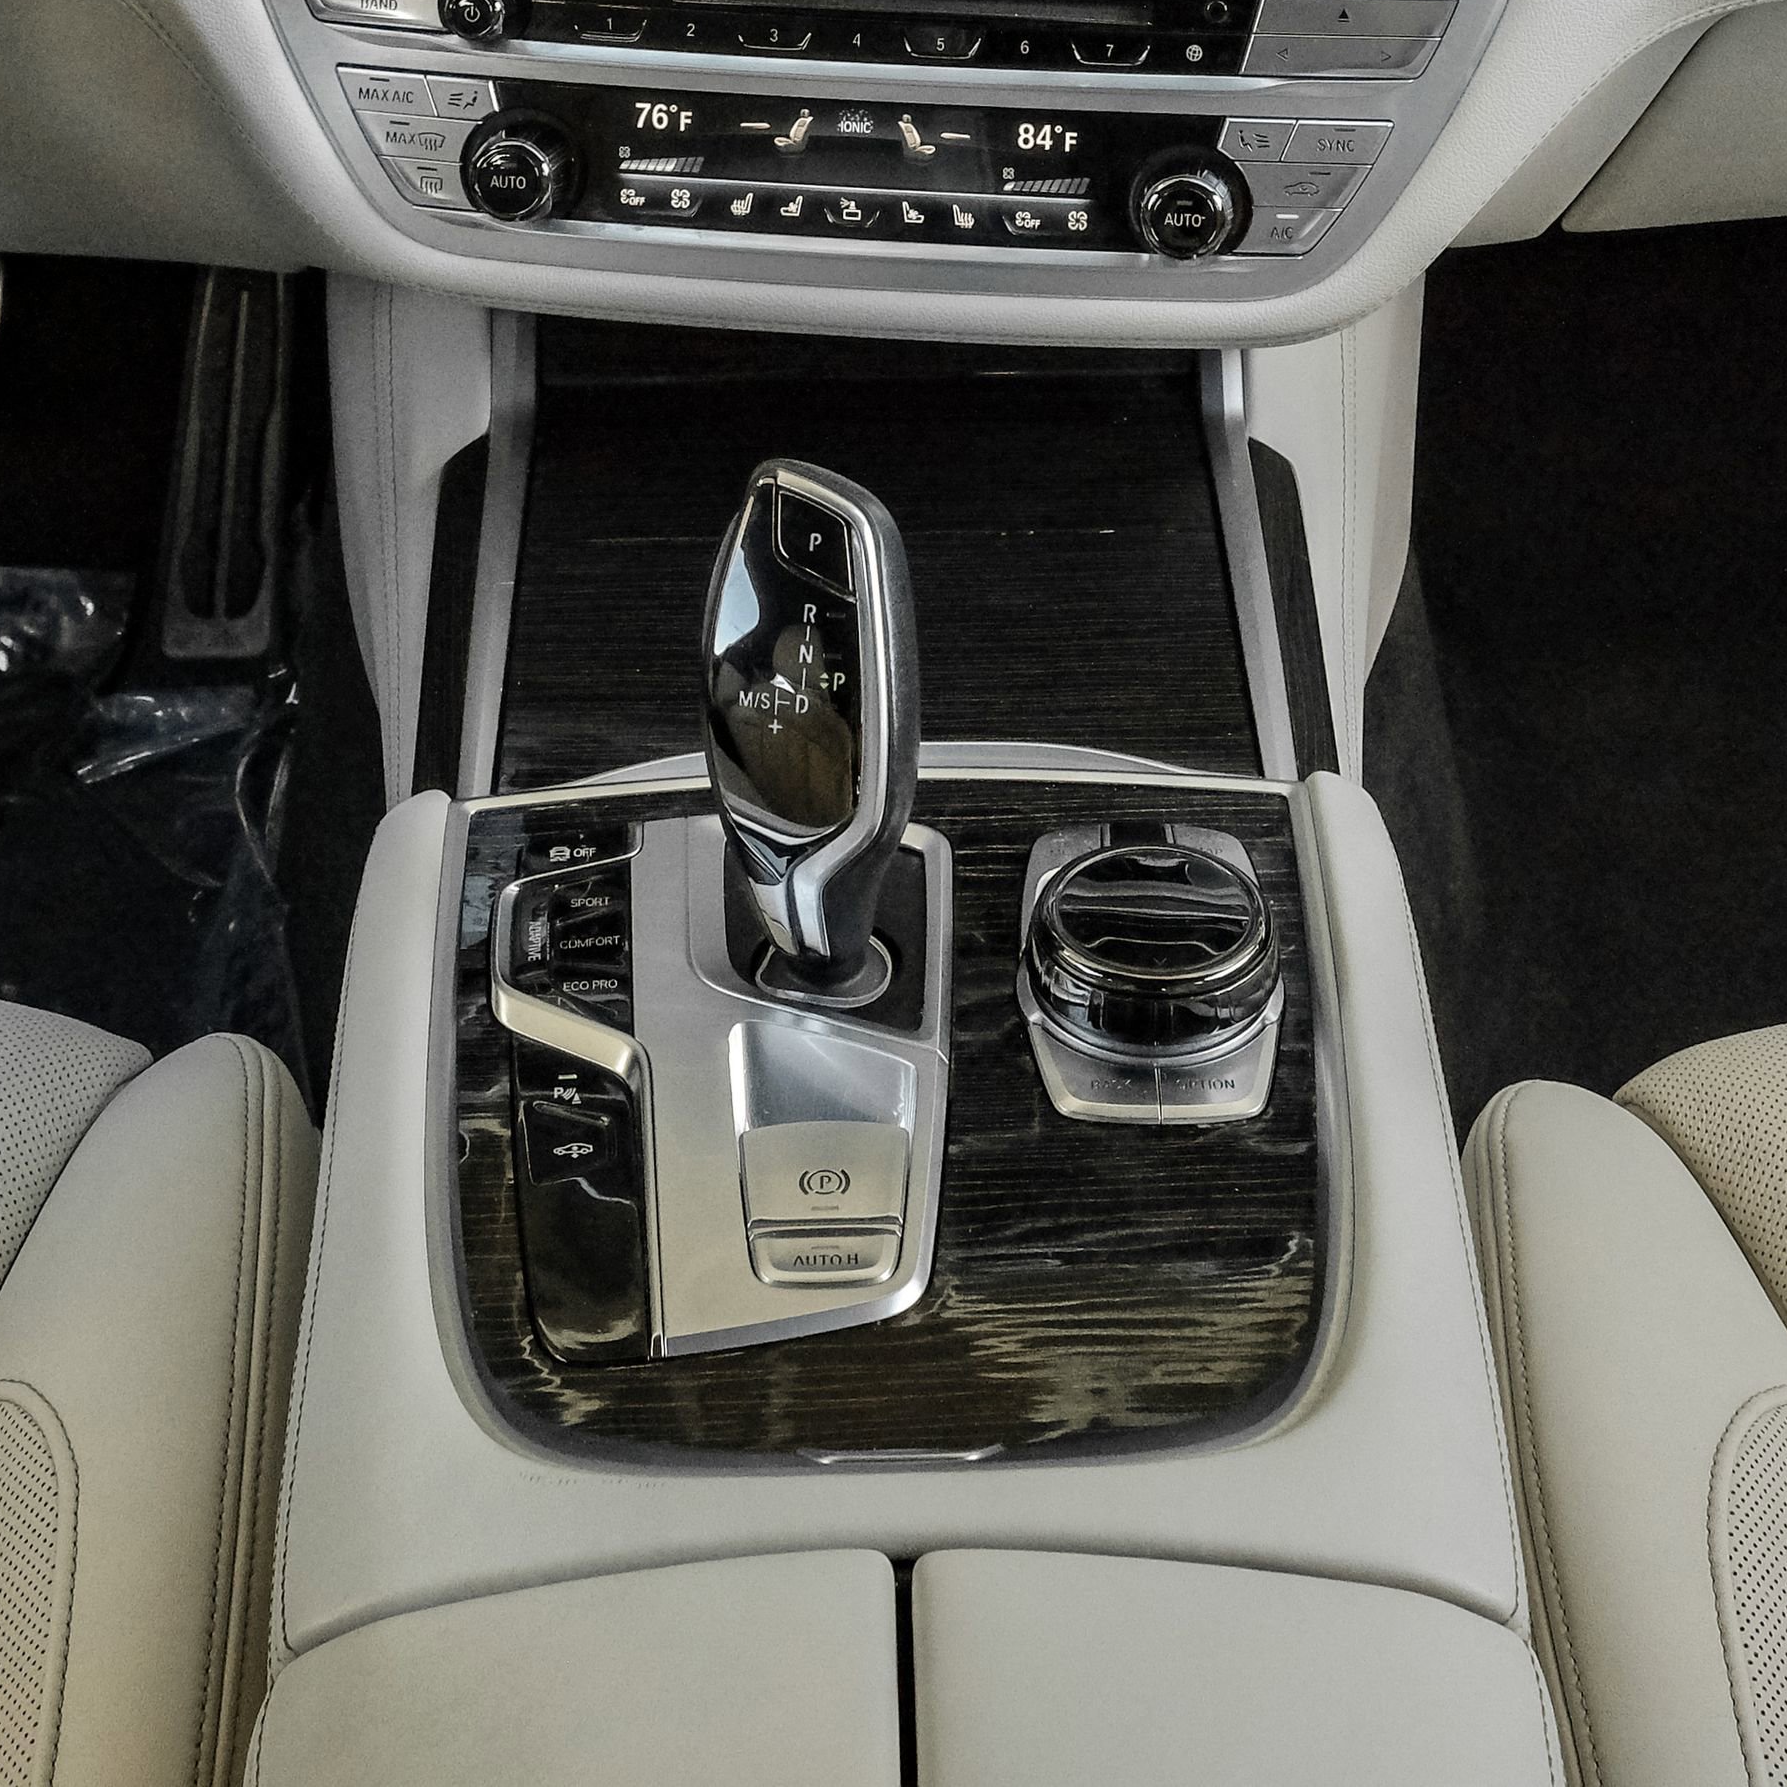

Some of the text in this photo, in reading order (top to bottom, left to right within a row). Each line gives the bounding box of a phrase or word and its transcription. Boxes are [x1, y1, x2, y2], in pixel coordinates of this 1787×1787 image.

[606, 17, 613, 31] 1
[686, 23, 696, 37] 2
[769, 28, 779, 43] 3
[852, 32, 862, 48] 4
[936, 38, 946, 51] 5
[1020, 40, 1030, 55] 6
[1105, 44, 1114, 58] 7
[358, 87, 414, 104] MAX A/C
[840, 119, 872, 134] IONIC
[385, 130, 416, 145] MAX
[1316, 138, 1355, 153] SYNC
[490, 175, 527, 190] AUTO
[628, 195, 646, 207] OFF
[1024, 218, 1041, 230] OFF
[1163, 211, 1202, 228] AUTO
[1270, 225, 1294, 240] A/C
[809, 532, 822, 552] P
[803, 603, 817, 624] R
[798, 644, 813, 664] N
[833, 671, 846, 692] P
[738, 689, 809, 714] M/S D
[573, 847, 597, 859] OFF
[569, 896, 611, 908] SPORT
[527, 921, 542, 962] ADAPTIVE
[559, 934, 621, 950] COMFORT
[563, 978, 619, 992] ECO PRO
[793, 1252, 859, 1267] AUTO H
